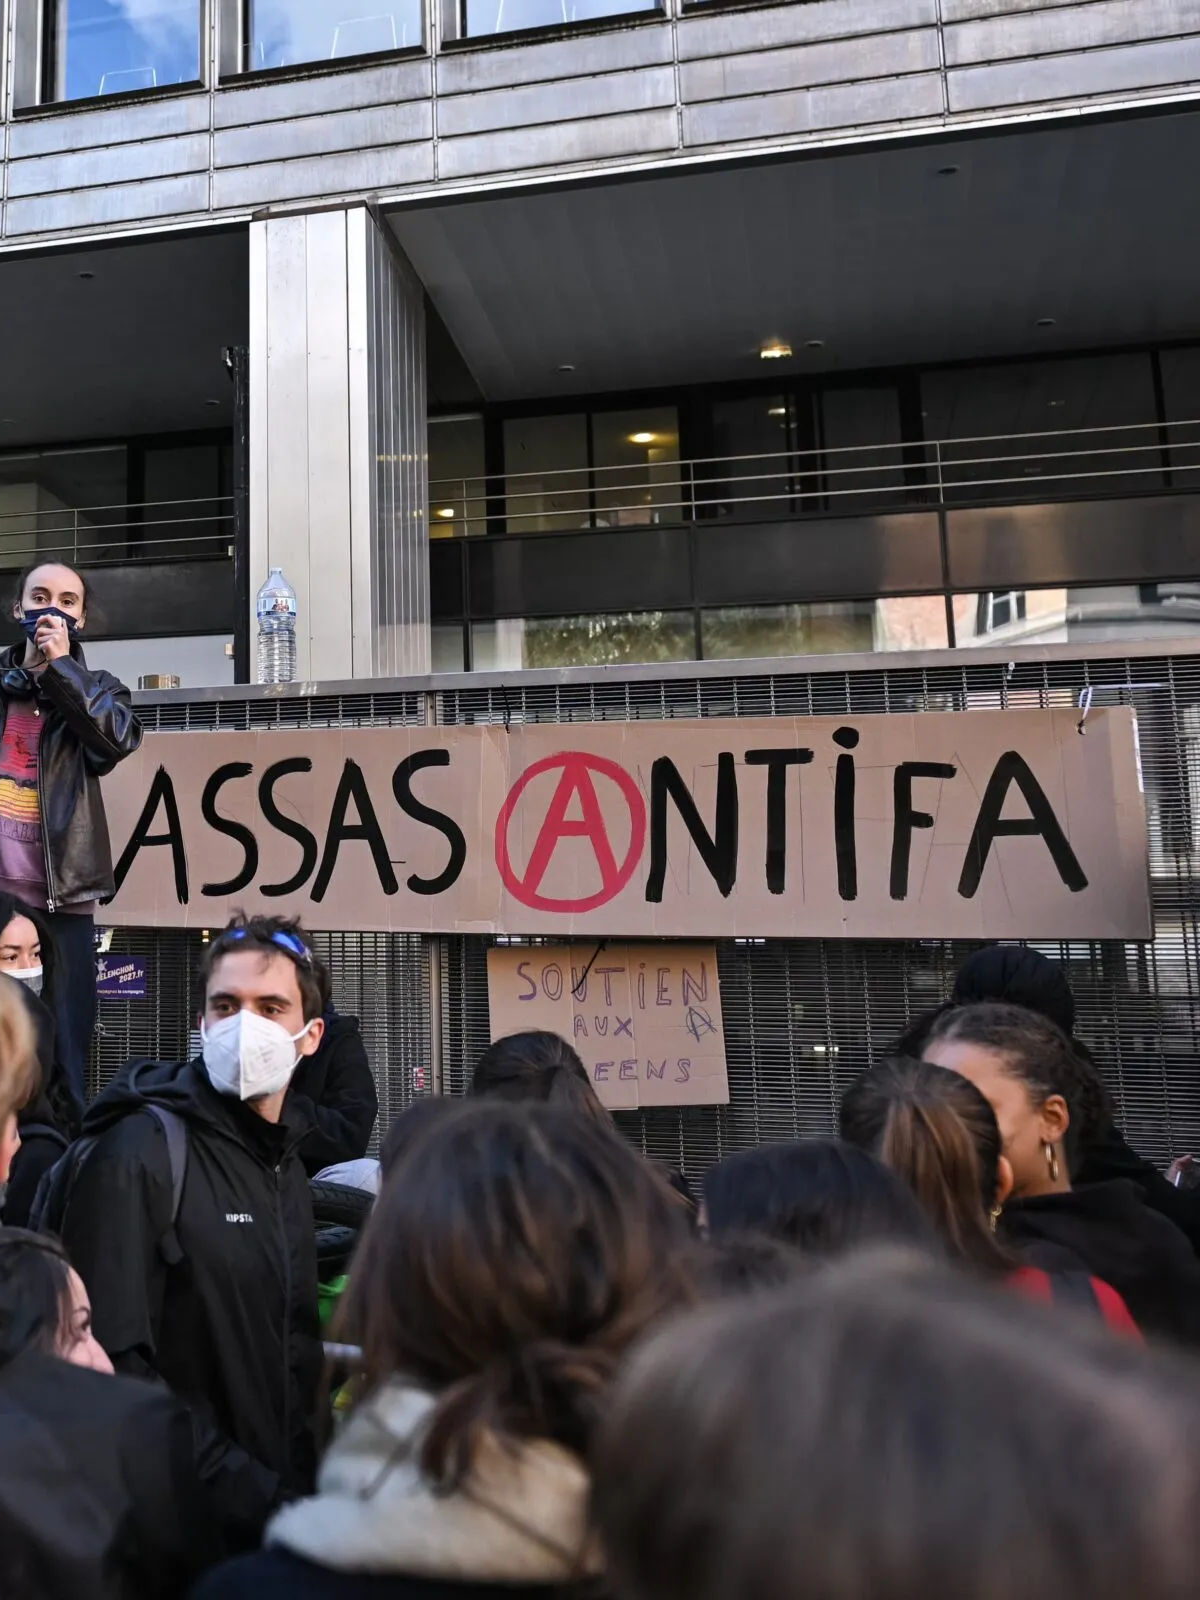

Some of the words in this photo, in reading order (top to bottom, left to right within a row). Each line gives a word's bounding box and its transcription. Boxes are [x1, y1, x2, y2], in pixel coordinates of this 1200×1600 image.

[97, 748, 467, 906] ASSAS
[119, 969, 145, 984] 2027.fr
[573, 1014, 634, 1037] AUX
[225, 1213, 253, 1223] KIPSTA
